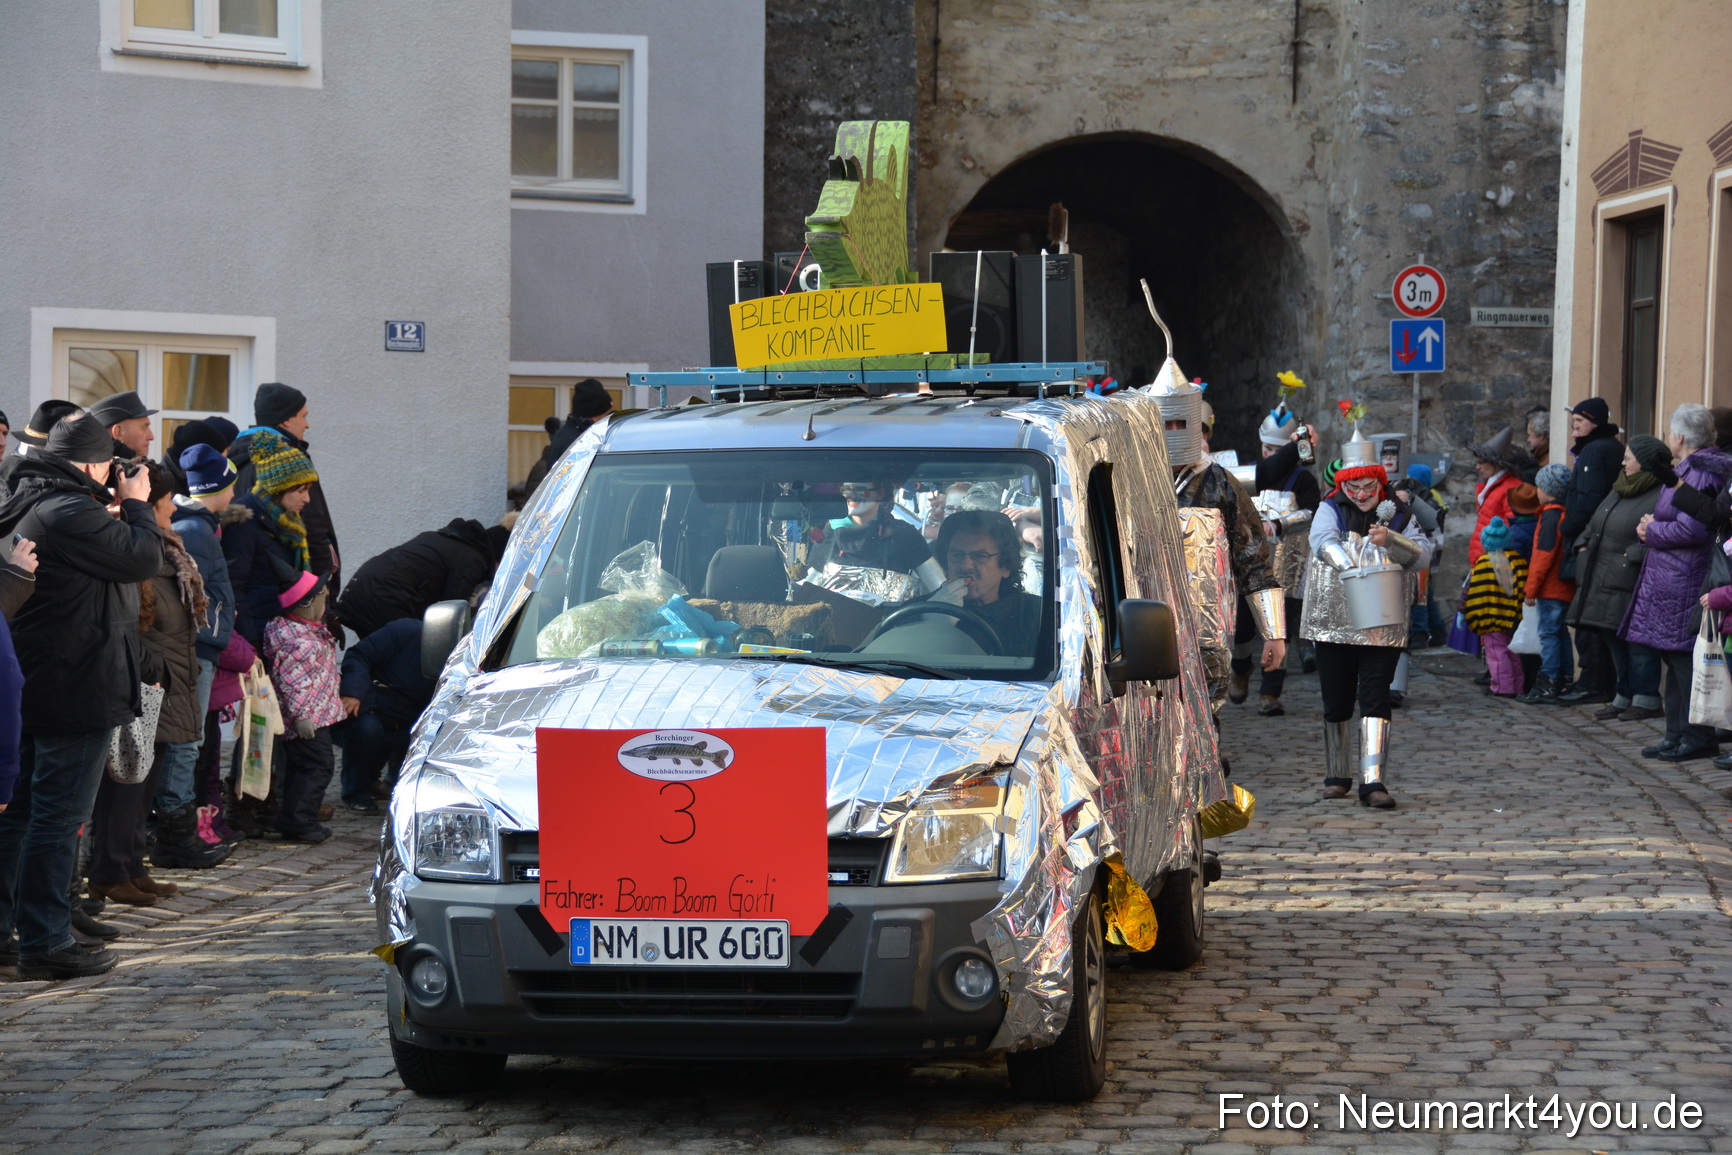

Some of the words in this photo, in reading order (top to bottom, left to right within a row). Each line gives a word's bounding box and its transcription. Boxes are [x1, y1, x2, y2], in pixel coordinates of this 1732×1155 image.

[394, 323, 417, 339] 12
[1477, 310, 1549, 325] Ringmauerweg
[767, 323, 876, 360] KOMPANIE
[655, 734, 695, 742] Berchinger
[659, 782, 696, 844] 3
[543, 879, 604, 910] Fahrer:
[615, 877, 667, 913] Boom
[673, 876, 717, 914] Boom
[577, 946, 585, 956] D
[593, 925, 638, 959] NM
[663, 926, 709, 960] UR
[718, 926, 784, 960] 600
